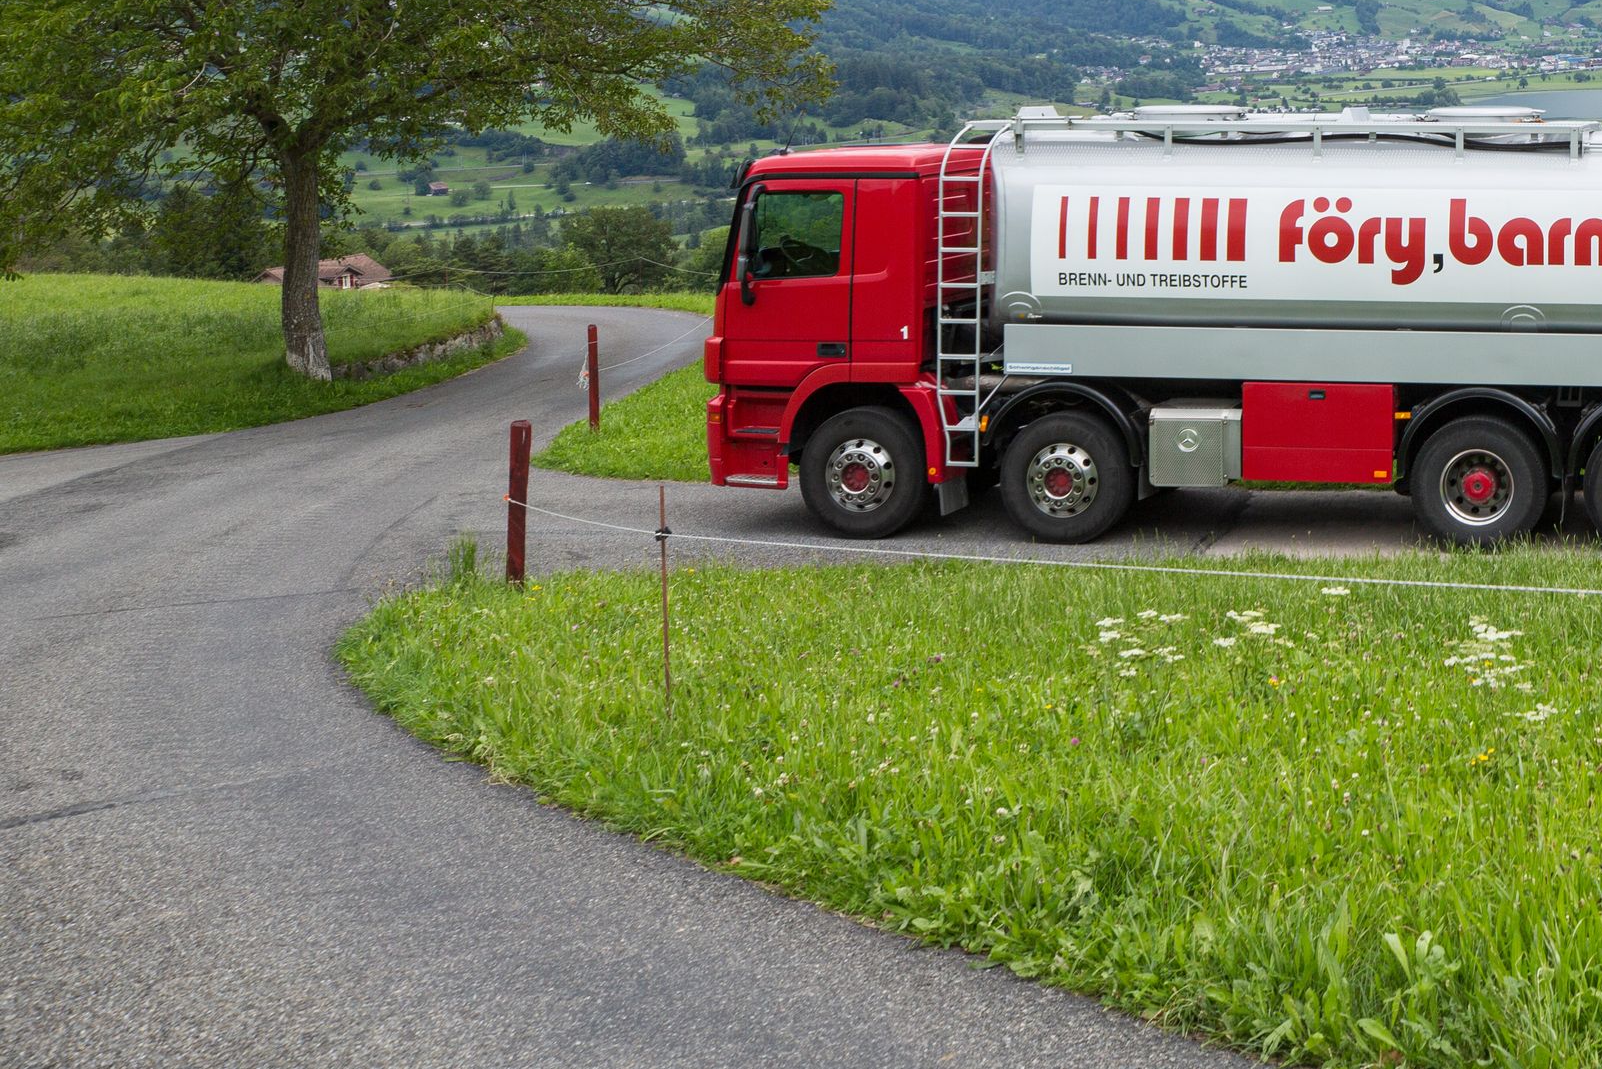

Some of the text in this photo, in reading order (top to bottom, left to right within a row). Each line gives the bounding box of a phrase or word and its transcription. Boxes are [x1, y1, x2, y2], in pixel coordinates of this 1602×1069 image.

[1058, 272, 1248, 289] BRENN- UND TREIBSTOFFE
[900, 325, 909, 340] 1
